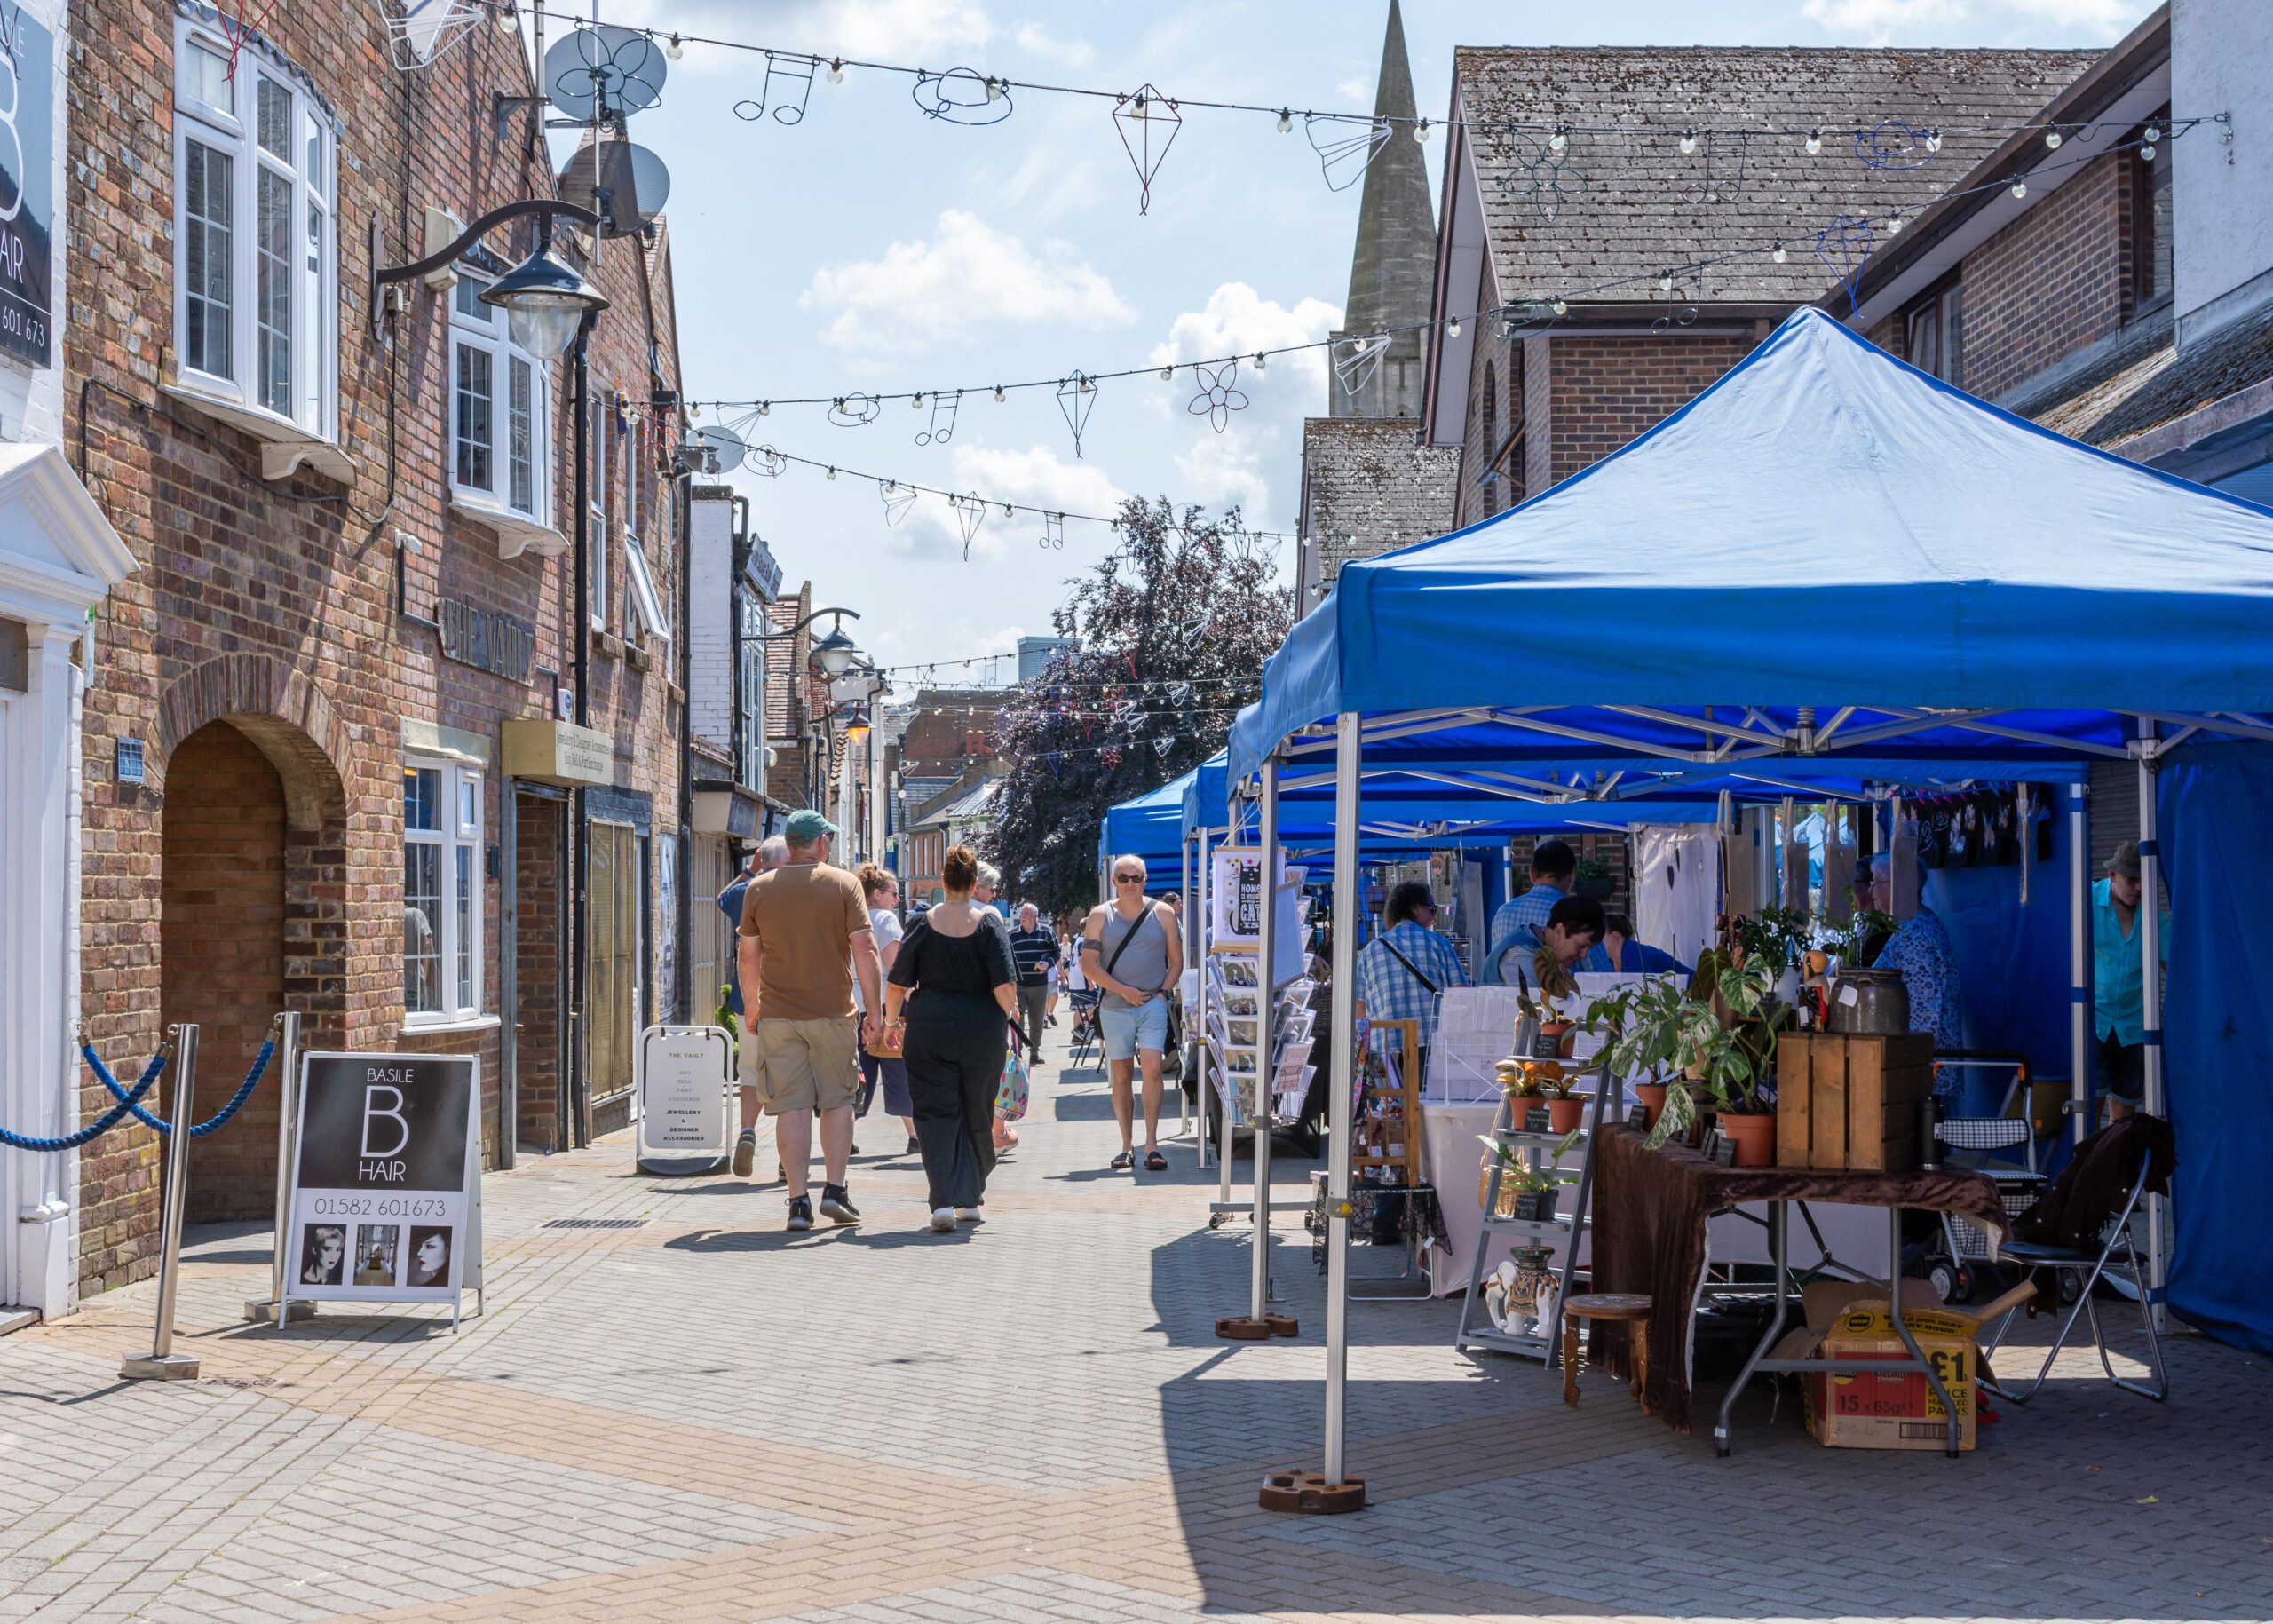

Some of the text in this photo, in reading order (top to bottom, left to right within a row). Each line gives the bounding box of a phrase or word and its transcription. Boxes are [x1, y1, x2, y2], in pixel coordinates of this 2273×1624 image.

[0, 13, 25, 59] SILE
[0, 229, 23, 284] AIR
[2, 305, 44, 347] 601 673
[444, 598, 535, 688] THE VAULT
[1240, 904, 1261, 922] CAT
[367, 1068, 415, 1083] BASILE
[360, 1085, 409, 1158] B
[358, 1161, 407, 1182] HAIR
[314, 1198, 446, 1216] 01582 601673
[1916, 1318, 1965, 1328] HOLIDAY
[1925, 1324, 1955, 1334] HOUR
[1929, 1351, 1964, 1382] £1
[1928, 1388, 1968, 1398] PICE
[1840, 1394, 1860, 1412] 15
